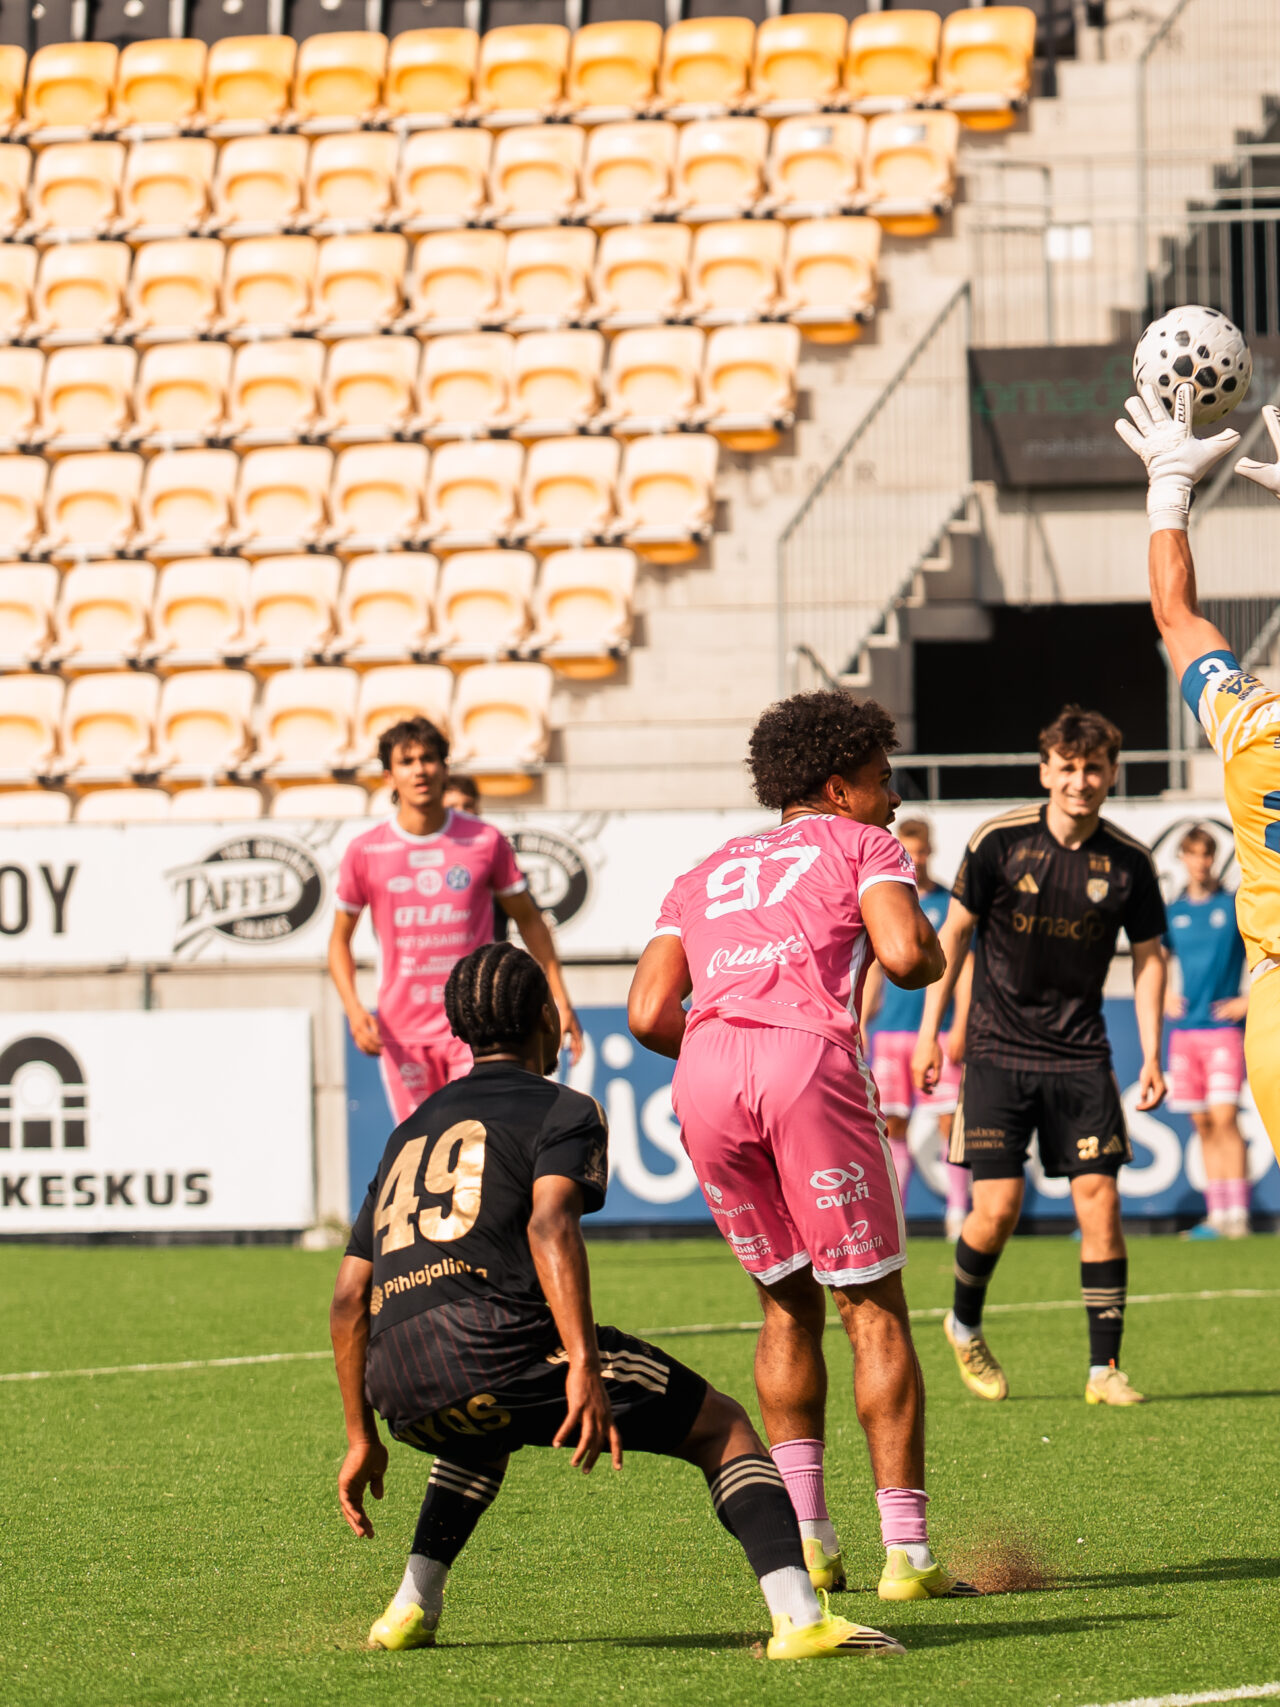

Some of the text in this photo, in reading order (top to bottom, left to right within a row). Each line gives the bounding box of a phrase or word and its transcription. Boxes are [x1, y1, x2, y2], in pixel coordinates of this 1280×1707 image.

[0, 864, 79, 934] OY
[704, 845, 821, 920] 97
[2, 1172, 212, 1207] KESKUS
[374, 1119, 487, 1256] 49
[816, 1182, 870, 1210] ow.fi
